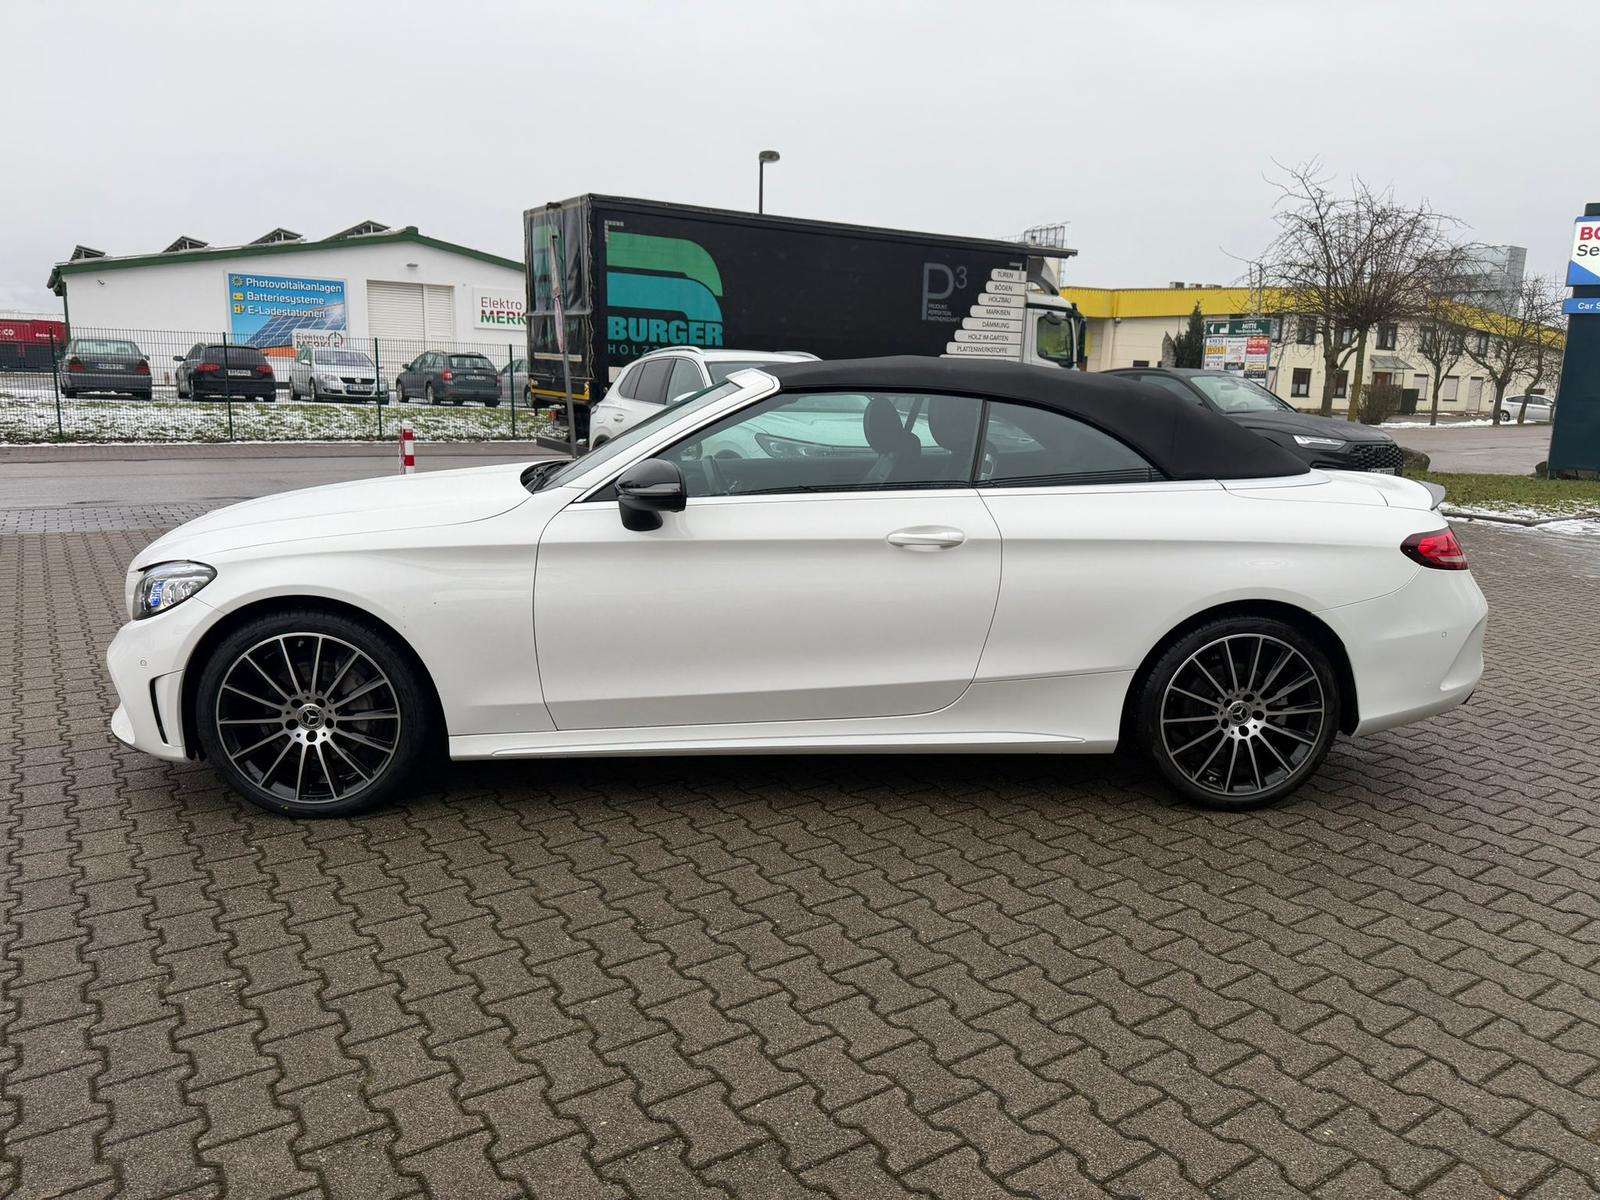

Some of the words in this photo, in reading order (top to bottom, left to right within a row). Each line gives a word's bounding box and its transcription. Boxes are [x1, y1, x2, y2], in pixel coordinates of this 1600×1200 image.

[246, 277, 342, 293] Photovoltaikanlagen
[247, 291, 325, 305] Batteriesysteme
[480, 296, 523, 311] Elektro
[248, 305, 326, 318] E-Ladestationen
[985, 308, 1011, 317] MARKISEN
[1578, 302, 1593, 310] Car
[607, 316, 724, 346] BURGER
[981, 320, 1010, 330] DÄMMUNG
